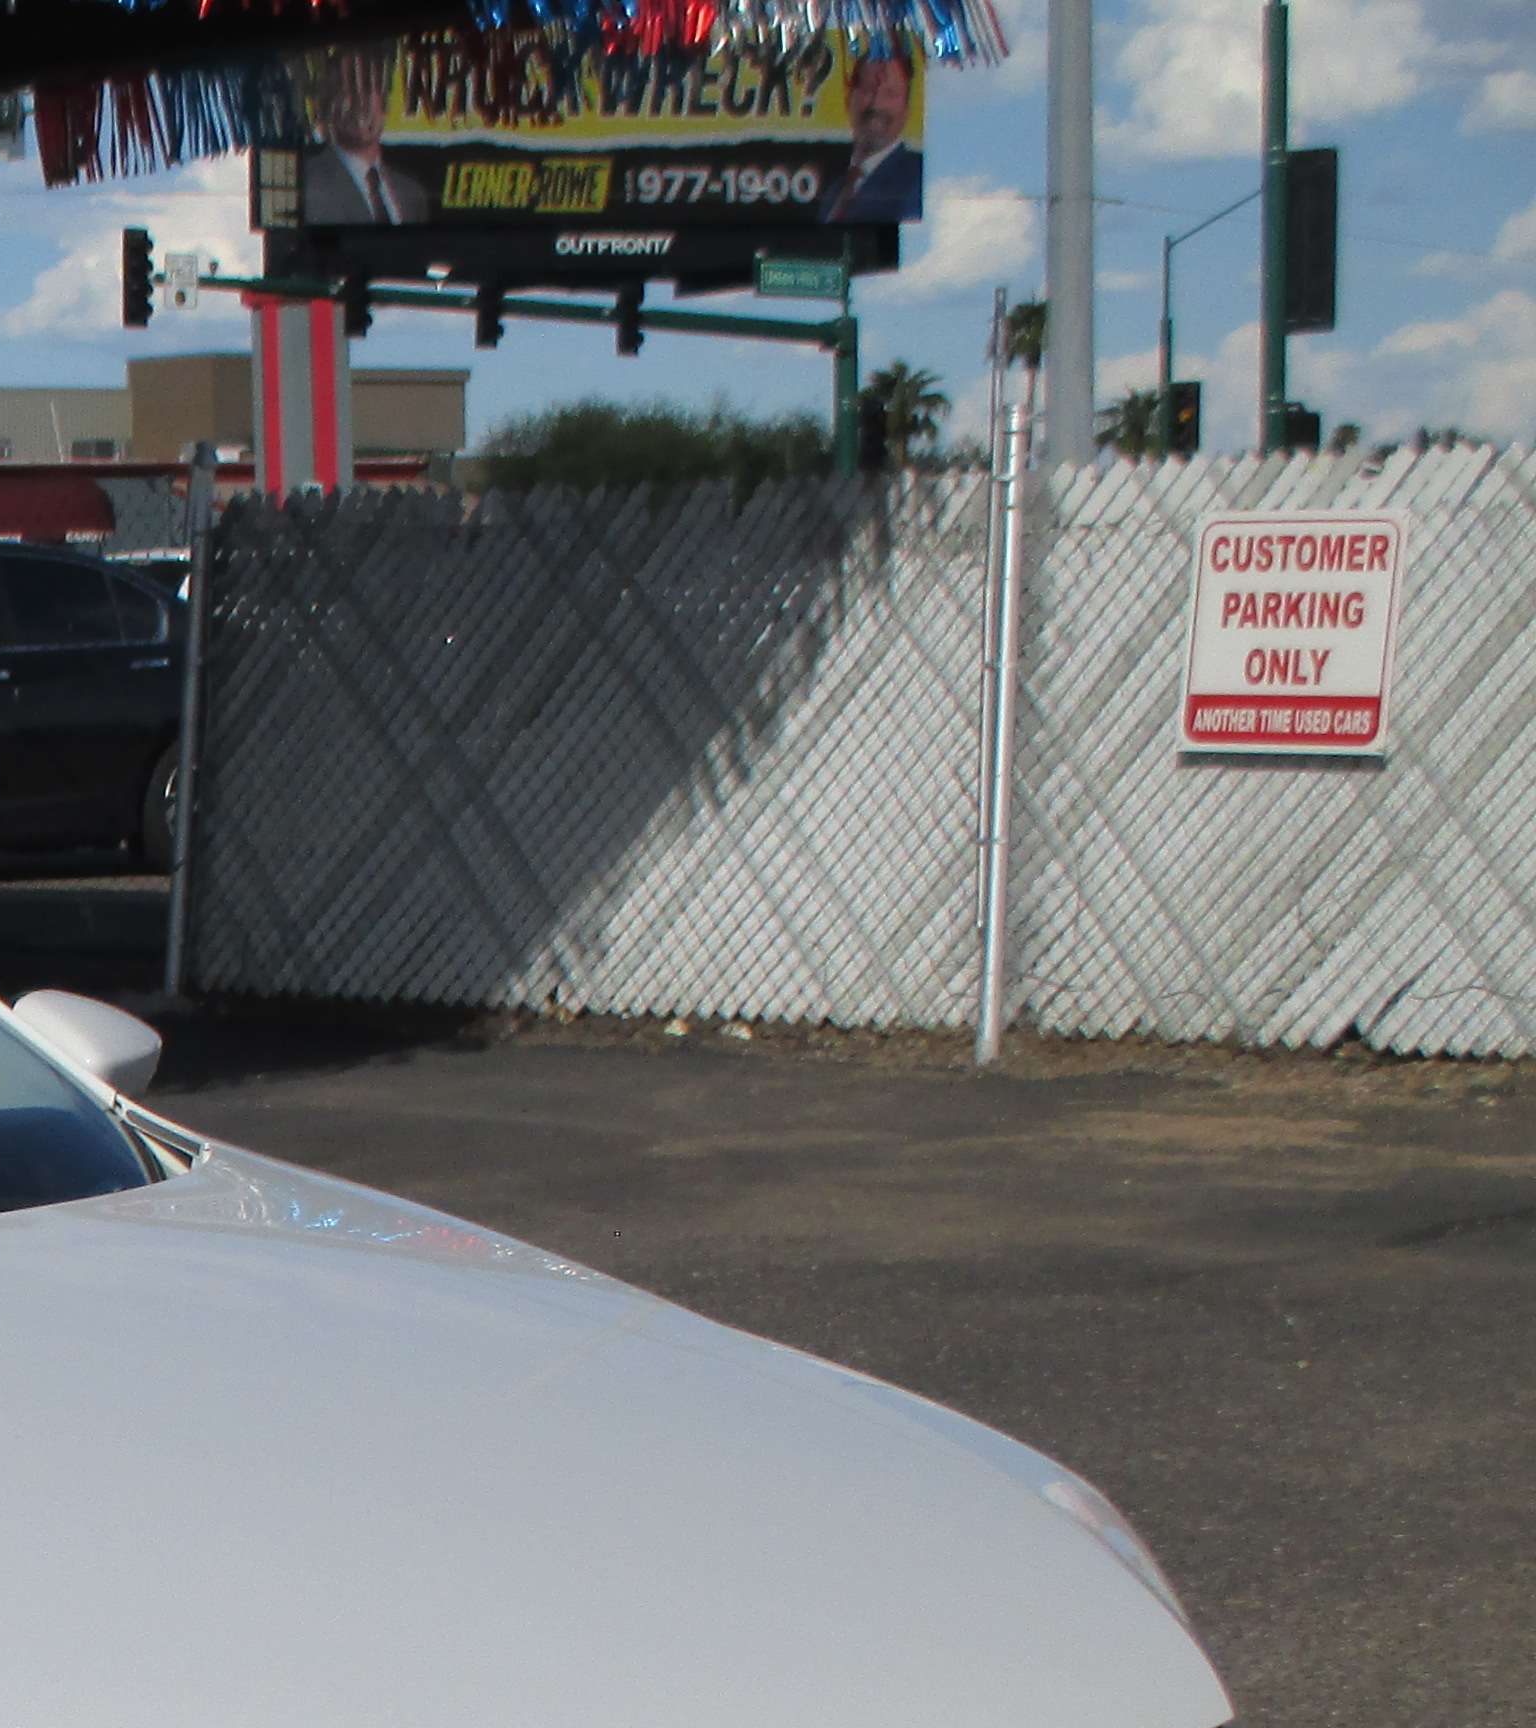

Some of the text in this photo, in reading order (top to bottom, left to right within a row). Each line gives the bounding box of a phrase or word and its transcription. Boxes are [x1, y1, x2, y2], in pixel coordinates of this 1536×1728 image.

[443, 162, 534, 208] LERNER
[636, 166, 820, 203] 977-1900
[1210, 535, 1389, 573] CUSTOMER
[1221, 591, 1364, 629] PARKING
[1244, 648, 1331, 685] ONLY
[1192, 708, 1370, 735] ANOTHER TIME USED CARS
